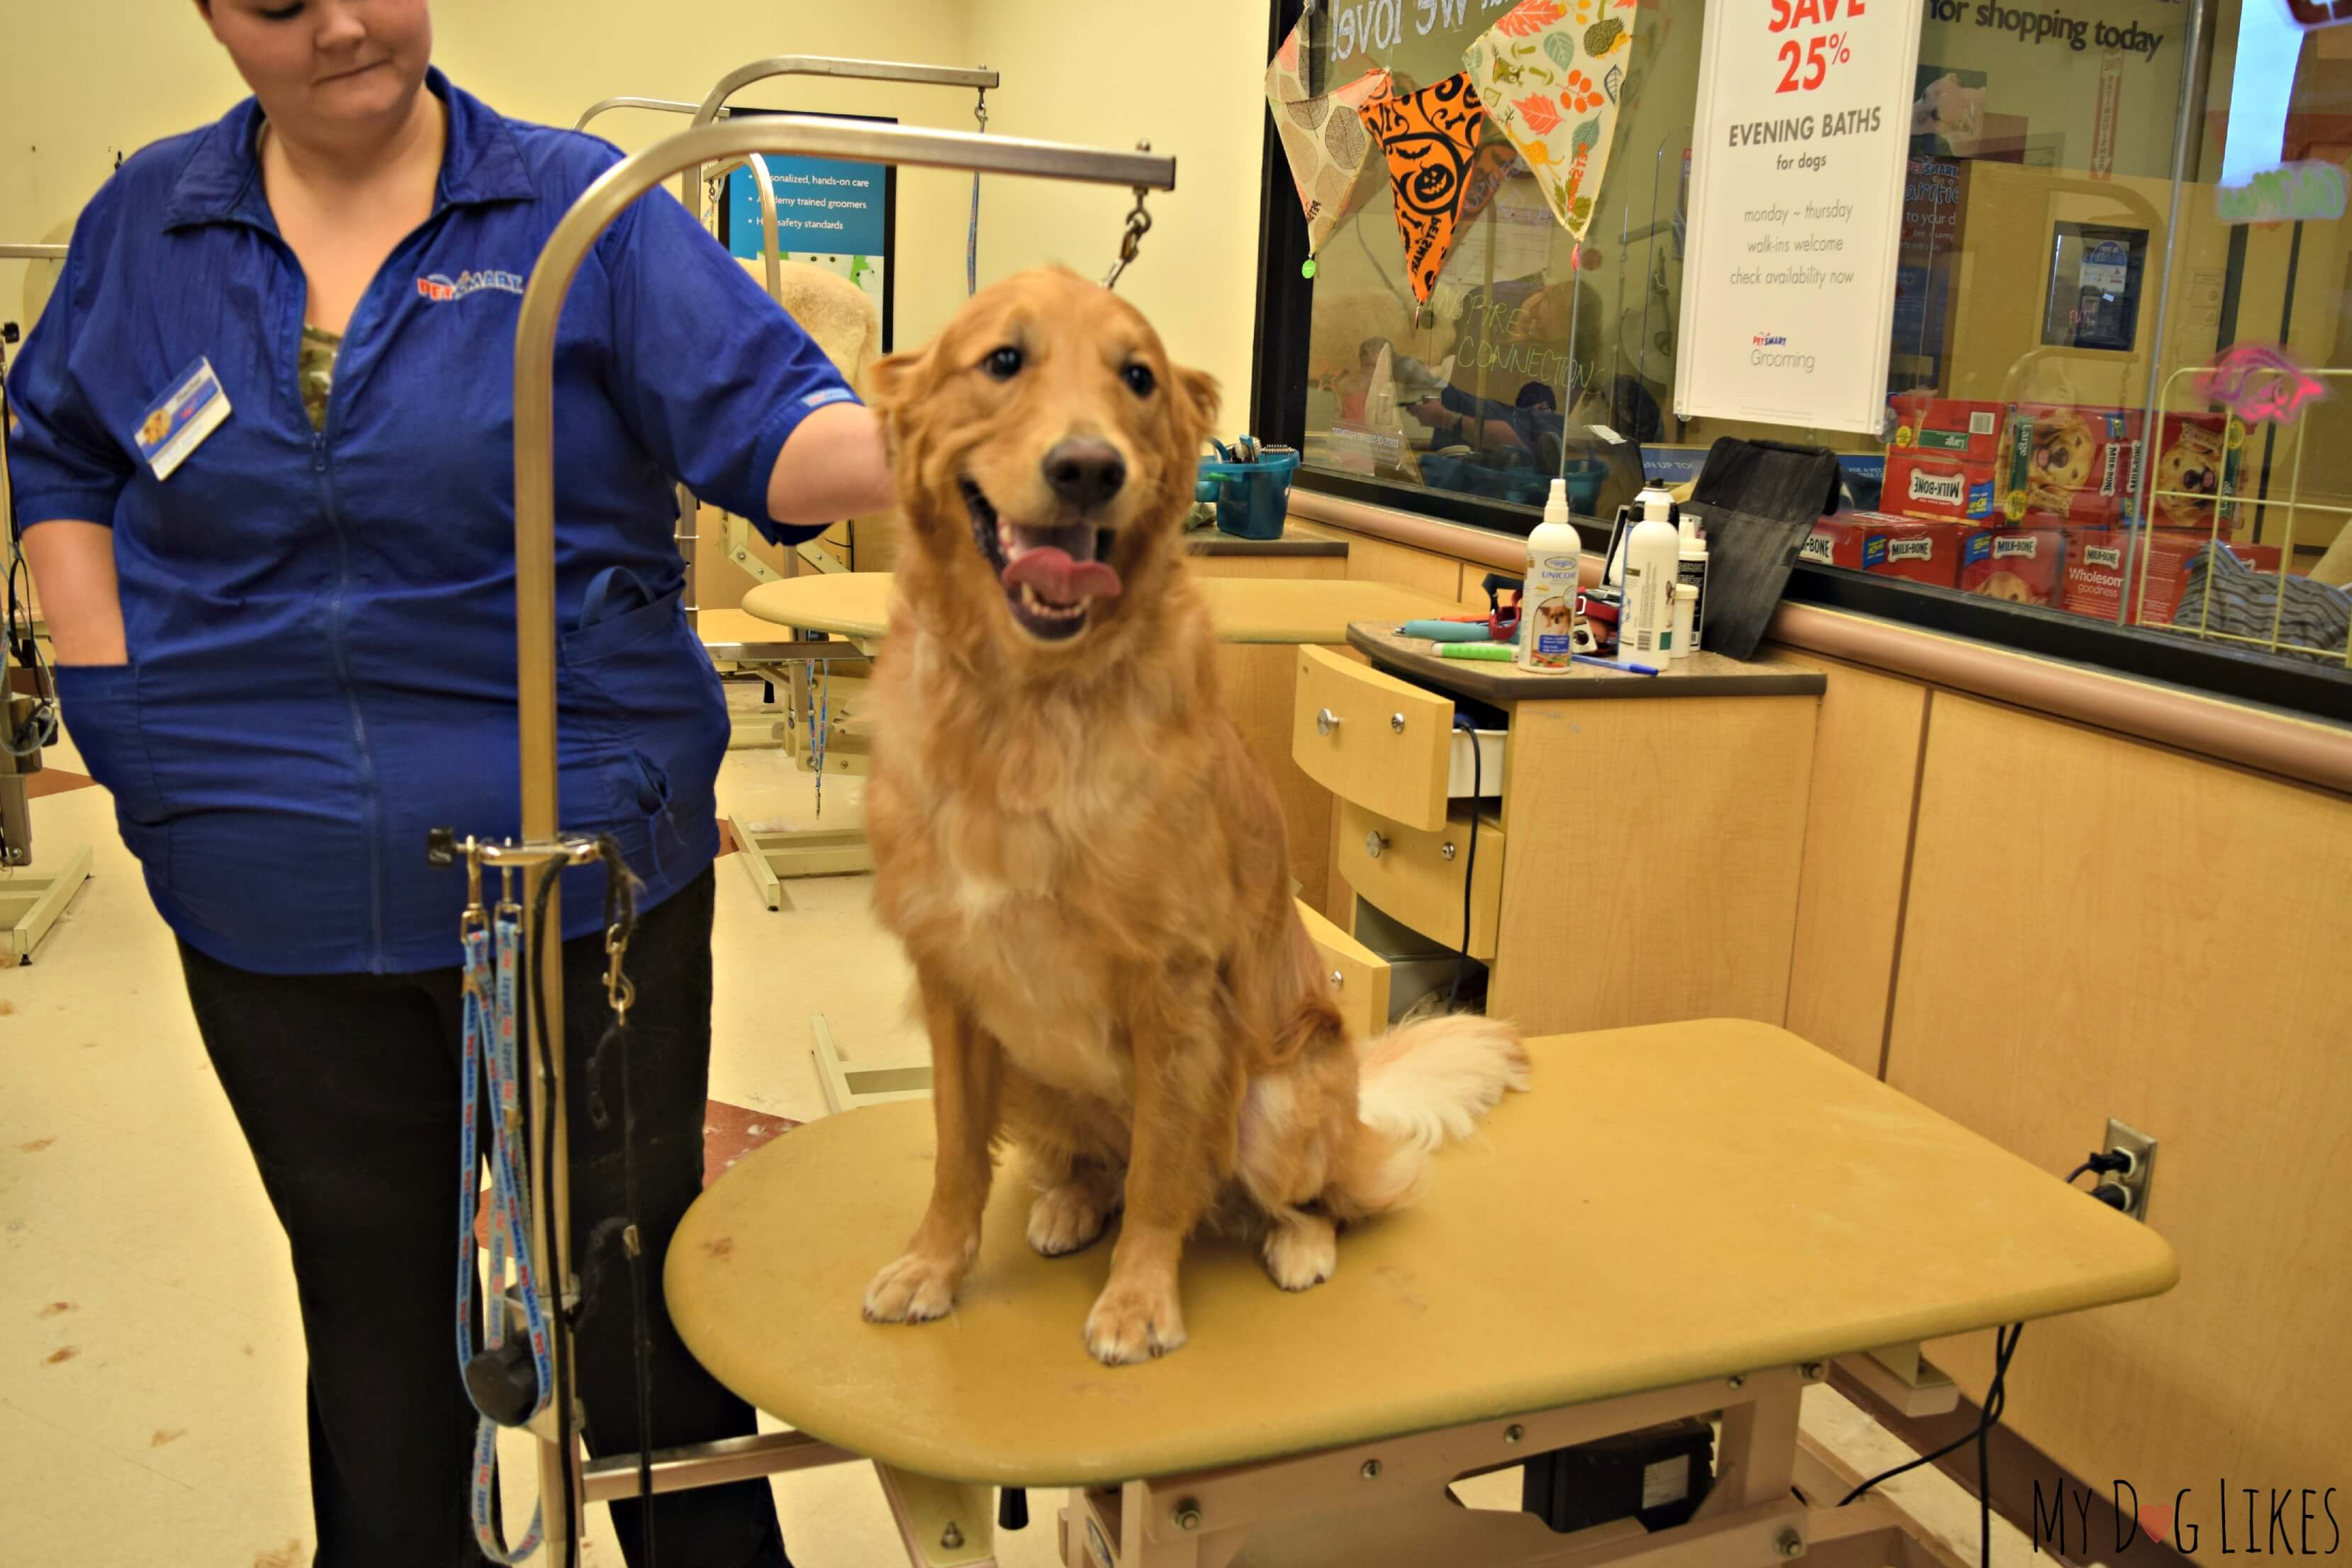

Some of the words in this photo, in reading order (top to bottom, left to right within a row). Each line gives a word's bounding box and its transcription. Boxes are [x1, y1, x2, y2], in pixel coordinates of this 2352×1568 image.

[1975, 4, 2088, 51] shopping
[2095, 21, 2163, 62] today
[1774, 31, 1850, 94] 25%
[1728, 116, 1815, 147] EVENING
[1822, 106, 1881, 138] BATHS
[1776, 154, 1793, 170] for
[1798, 152, 1827, 172] dogs
[768, 174, 811, 184] sonalized,
[812, 176, 851, 186] hands-on
[756, 196, 795, 207] Ademy
[797, 198, 826, 207] trained
[828, 199, 867, 209] groomers
[1744, 202, 1789, 225] monday
[1805, 198, 1854, 223] thursday
[777, 218, 802, 229] safety
[805, 220, 844, 230] standards
[1747, 233, 1790, 253] walk-ins
[1794, 233, 1844, 252] welcome
[417, 269, 524, 301] PETSMART
[1730, 266, 1761, 284] check
[1765, 264, 1826, 289] availability
[1830, 271, 1854, 284] now
[1752, 335, 1786, 346] PETSMART
[1751, 349, 1815, 374] Grooming
[2103, 447, 2118, 492] MILK-BONE
[1913, 476, 1961, 498] MILK-BONE
[1891, 542, 1930, 556] MILK-BONE
[1997, 539, 2034, 554] MILK-BONE
[2086, 549, 2117, 564] MILK-BONE
[2078, 583, 2118, 598] goodness
